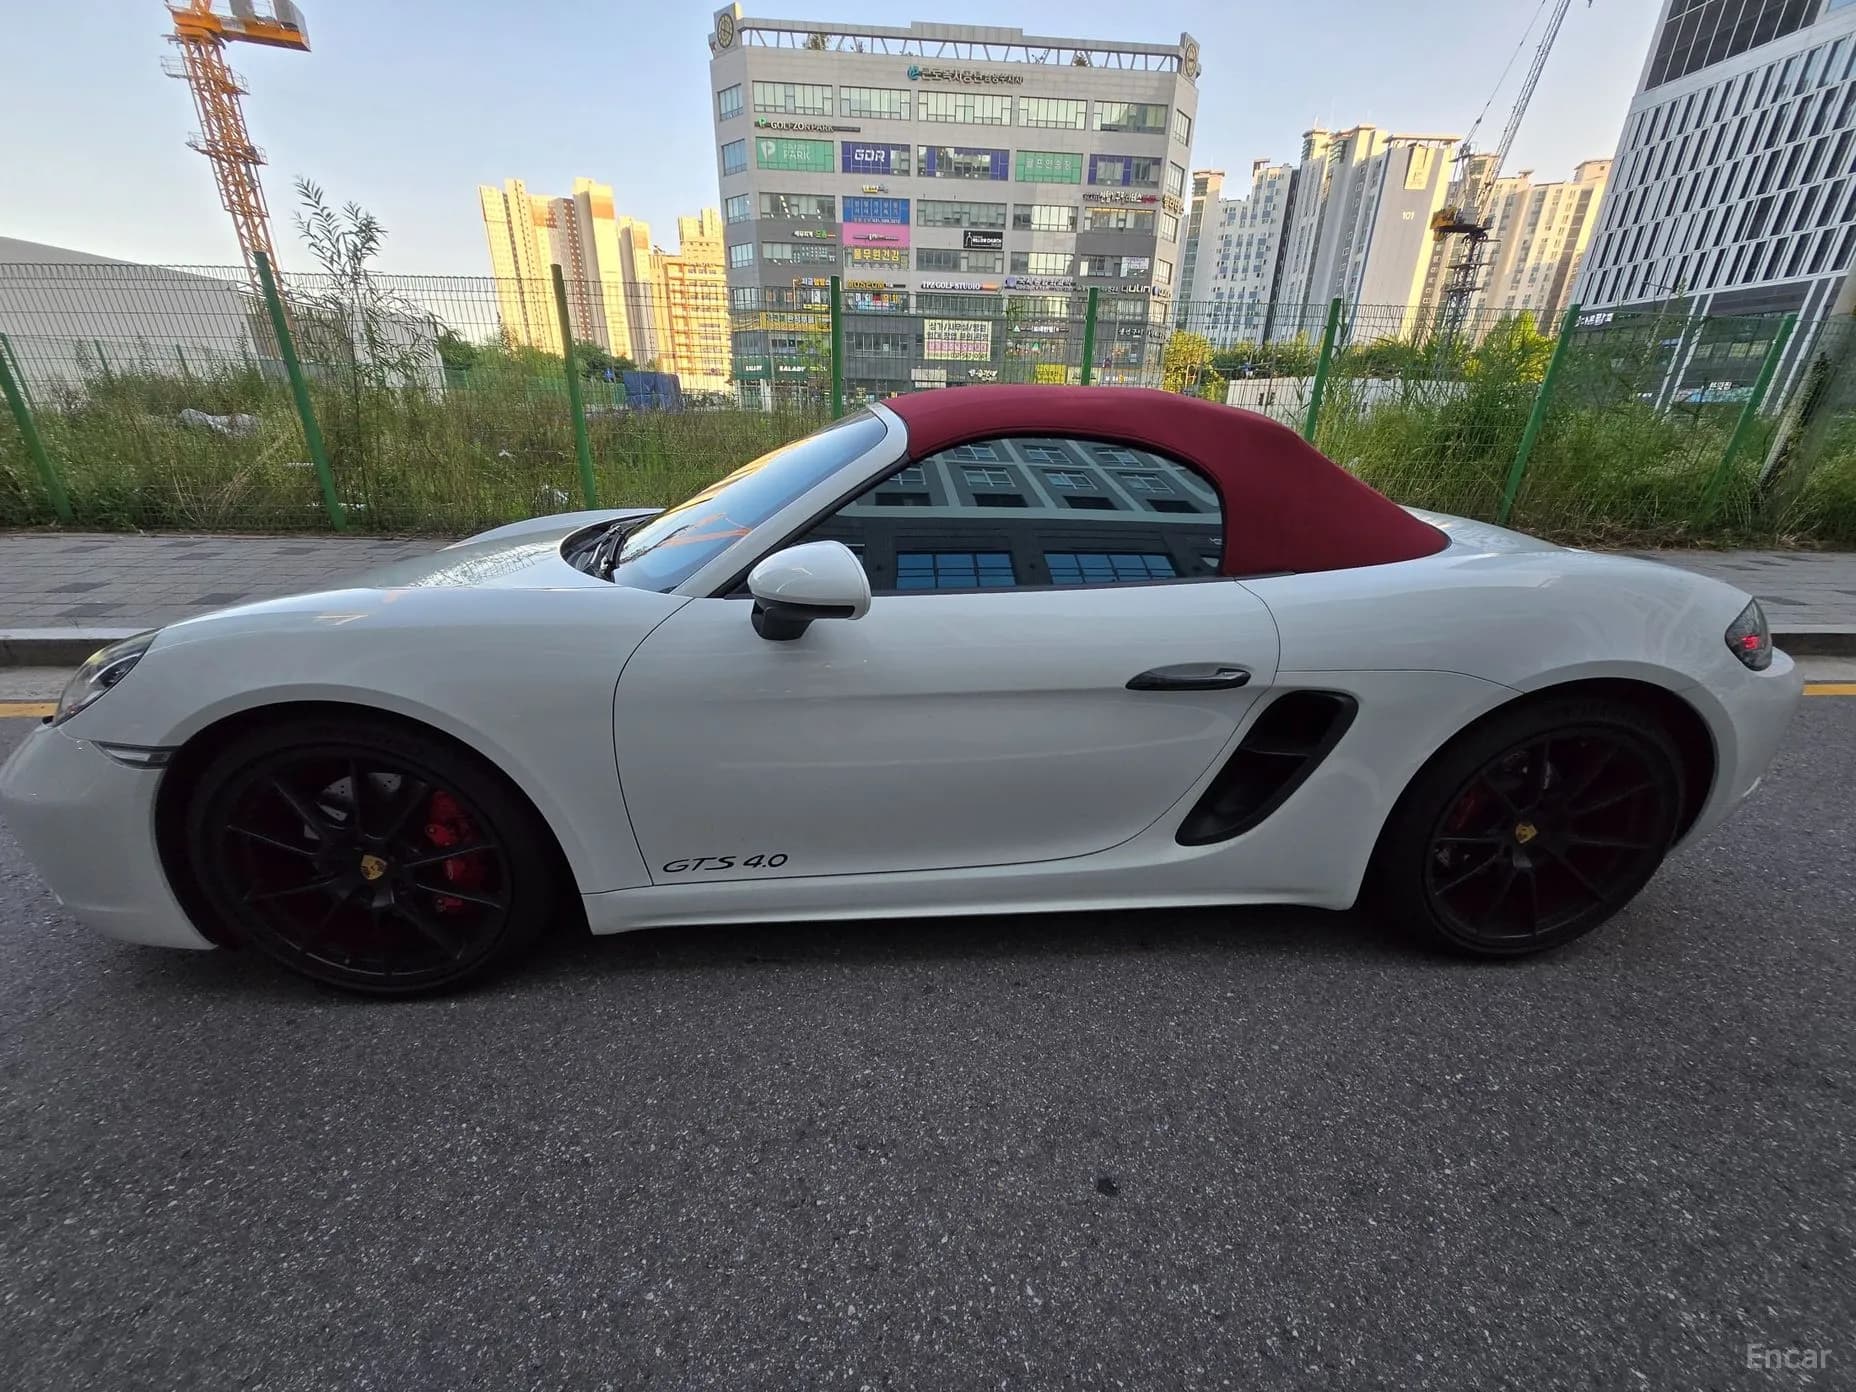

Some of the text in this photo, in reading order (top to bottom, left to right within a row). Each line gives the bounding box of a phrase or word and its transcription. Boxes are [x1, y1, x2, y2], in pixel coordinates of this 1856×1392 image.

[783, 150, 810, 161] PARK
[854, 149, 886, 162] GDR
[1402, 211, 1415, 221] 101
[954, 282, 981, 290] STUDIO
[662, 853, 788, 873] GTS 4.0
